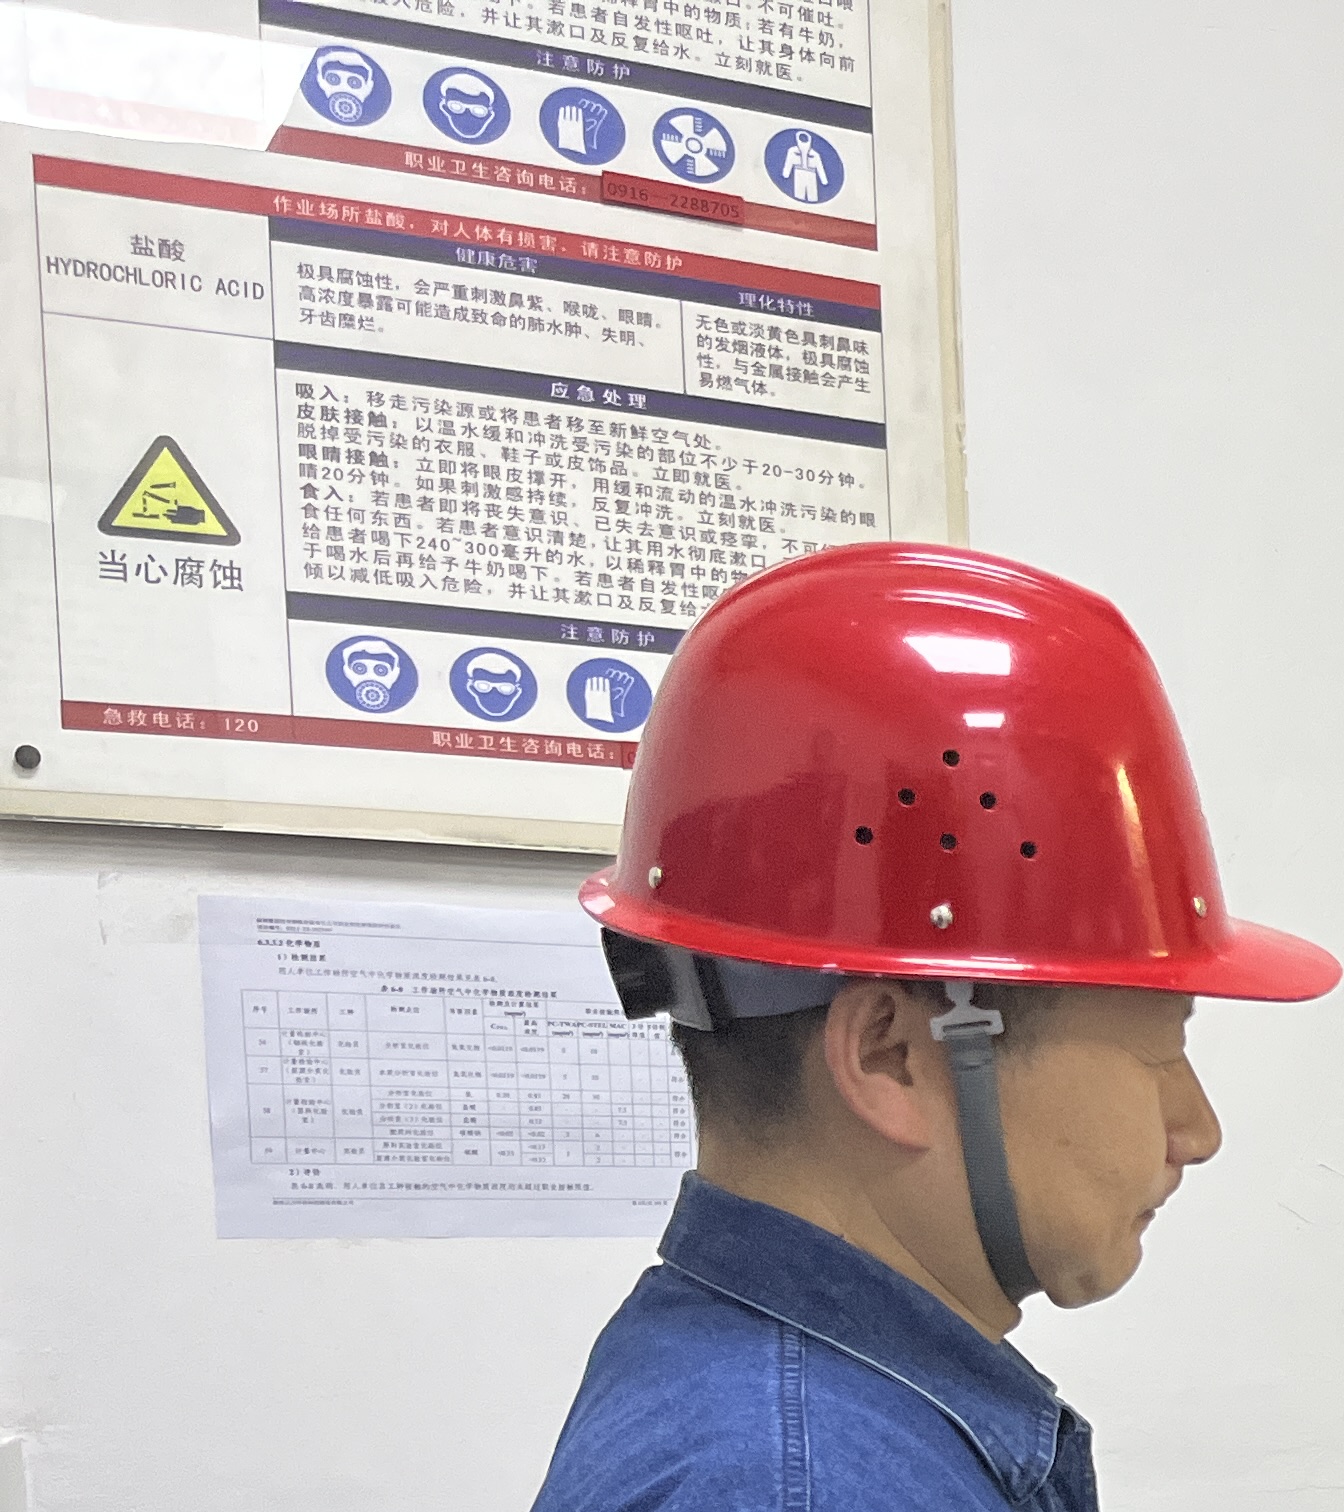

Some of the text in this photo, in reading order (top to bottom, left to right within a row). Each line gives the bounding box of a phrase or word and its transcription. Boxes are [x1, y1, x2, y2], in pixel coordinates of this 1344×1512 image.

[536, 49, 632, 81] 注意防护
[129, 234, 186, 263] 盐酸
[454, 245, 539, 275] 健康危害
[45, 255, 265, 301] HYDROCHLORIC ACID
[738, 291, 815, 318] 理化特性
[695, 313, 870, 356] 无色或淡黄色具刺鼻味
[550, 381, 647, 411] 应急处理
[98, 548, 244, 592] 当心腐蚀
[560, 623, 656, 648] 注意防护
